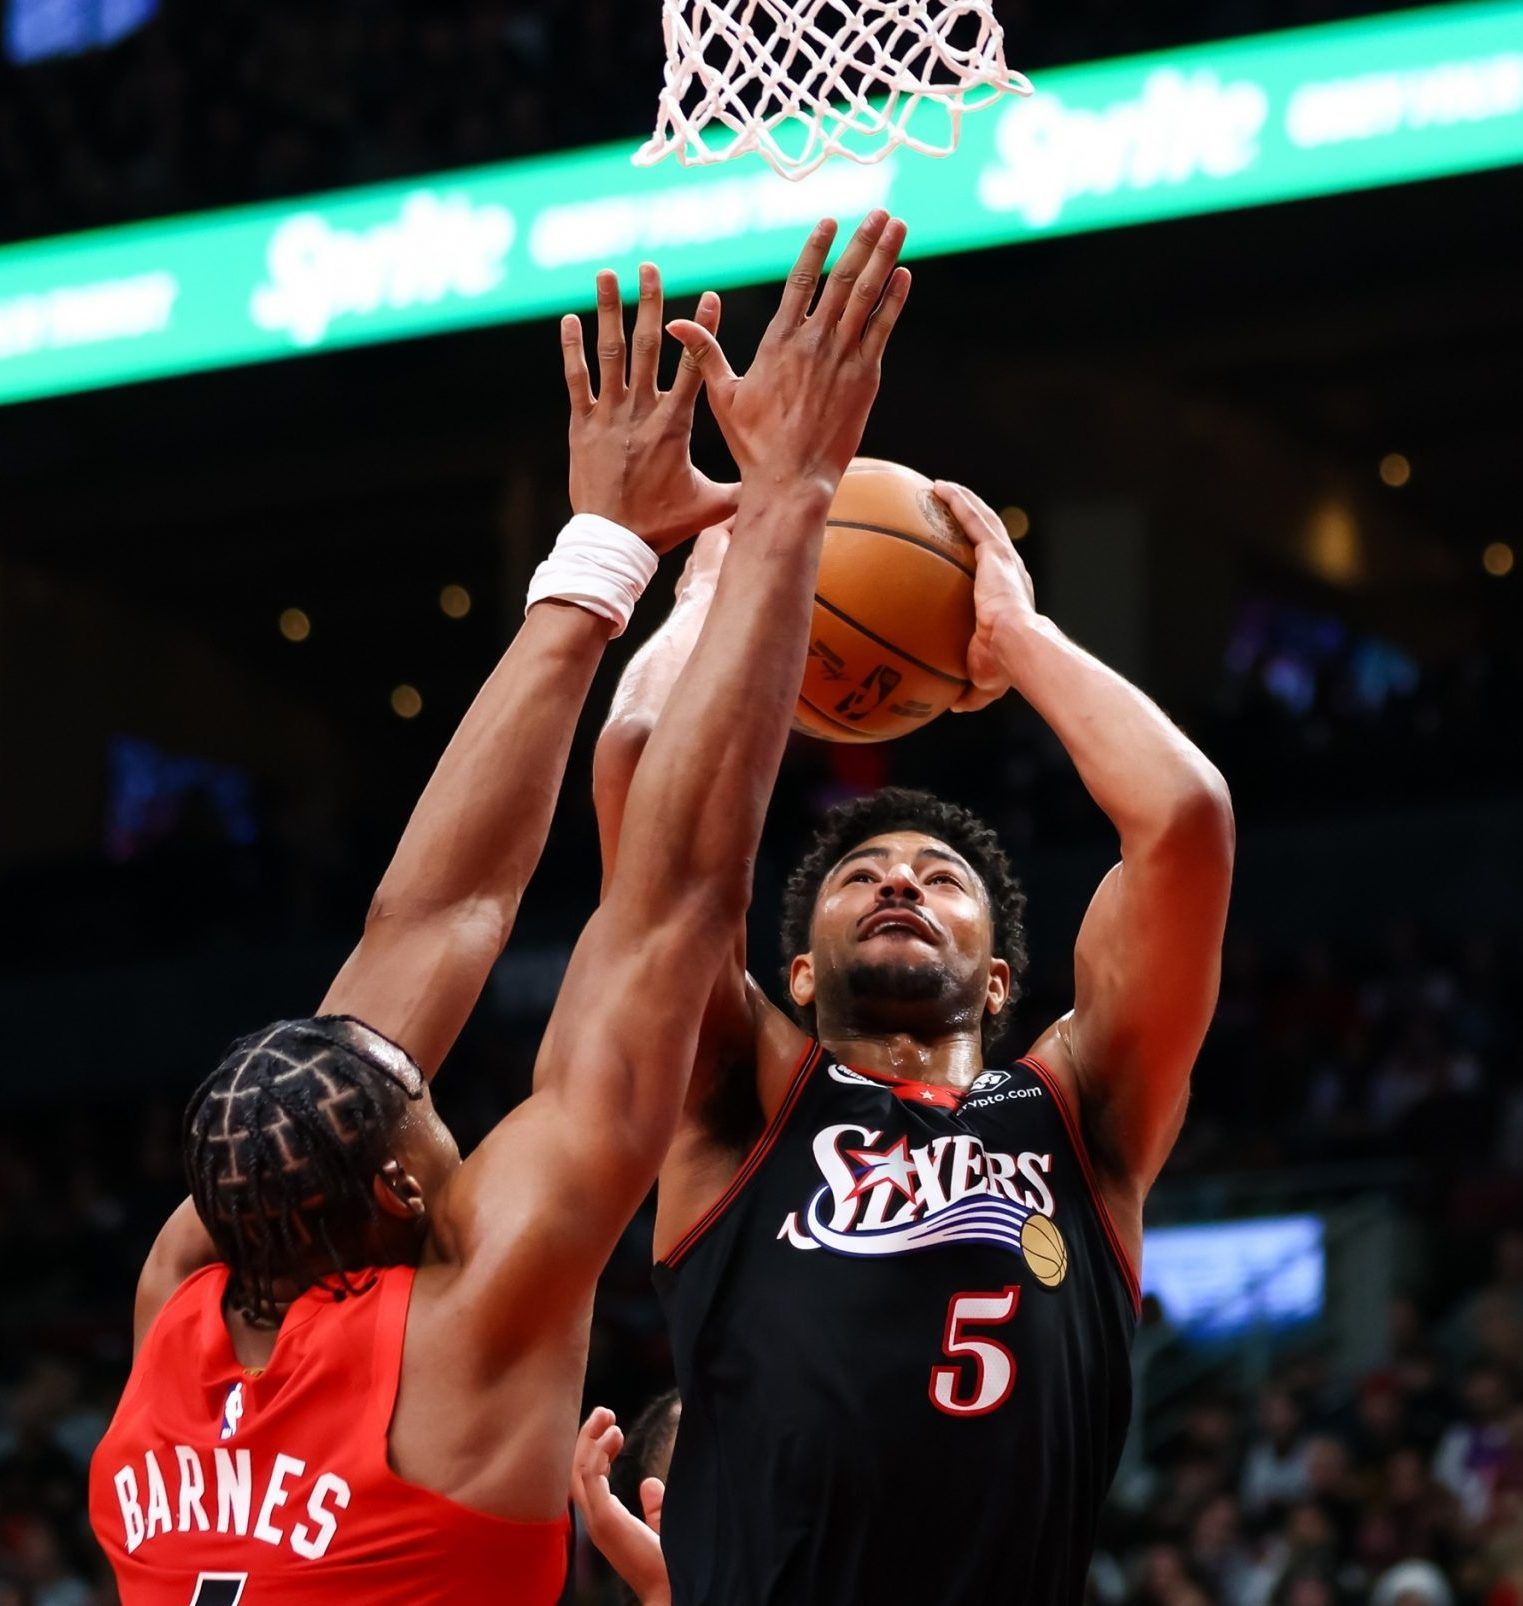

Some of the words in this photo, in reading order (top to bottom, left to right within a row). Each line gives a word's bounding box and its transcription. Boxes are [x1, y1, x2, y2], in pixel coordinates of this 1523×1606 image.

[777, 1123, 1055, 1250] SIXERS
[928, 1285, 1021, 1417] 5
[113, 1445, 351, 1560] BARNES
